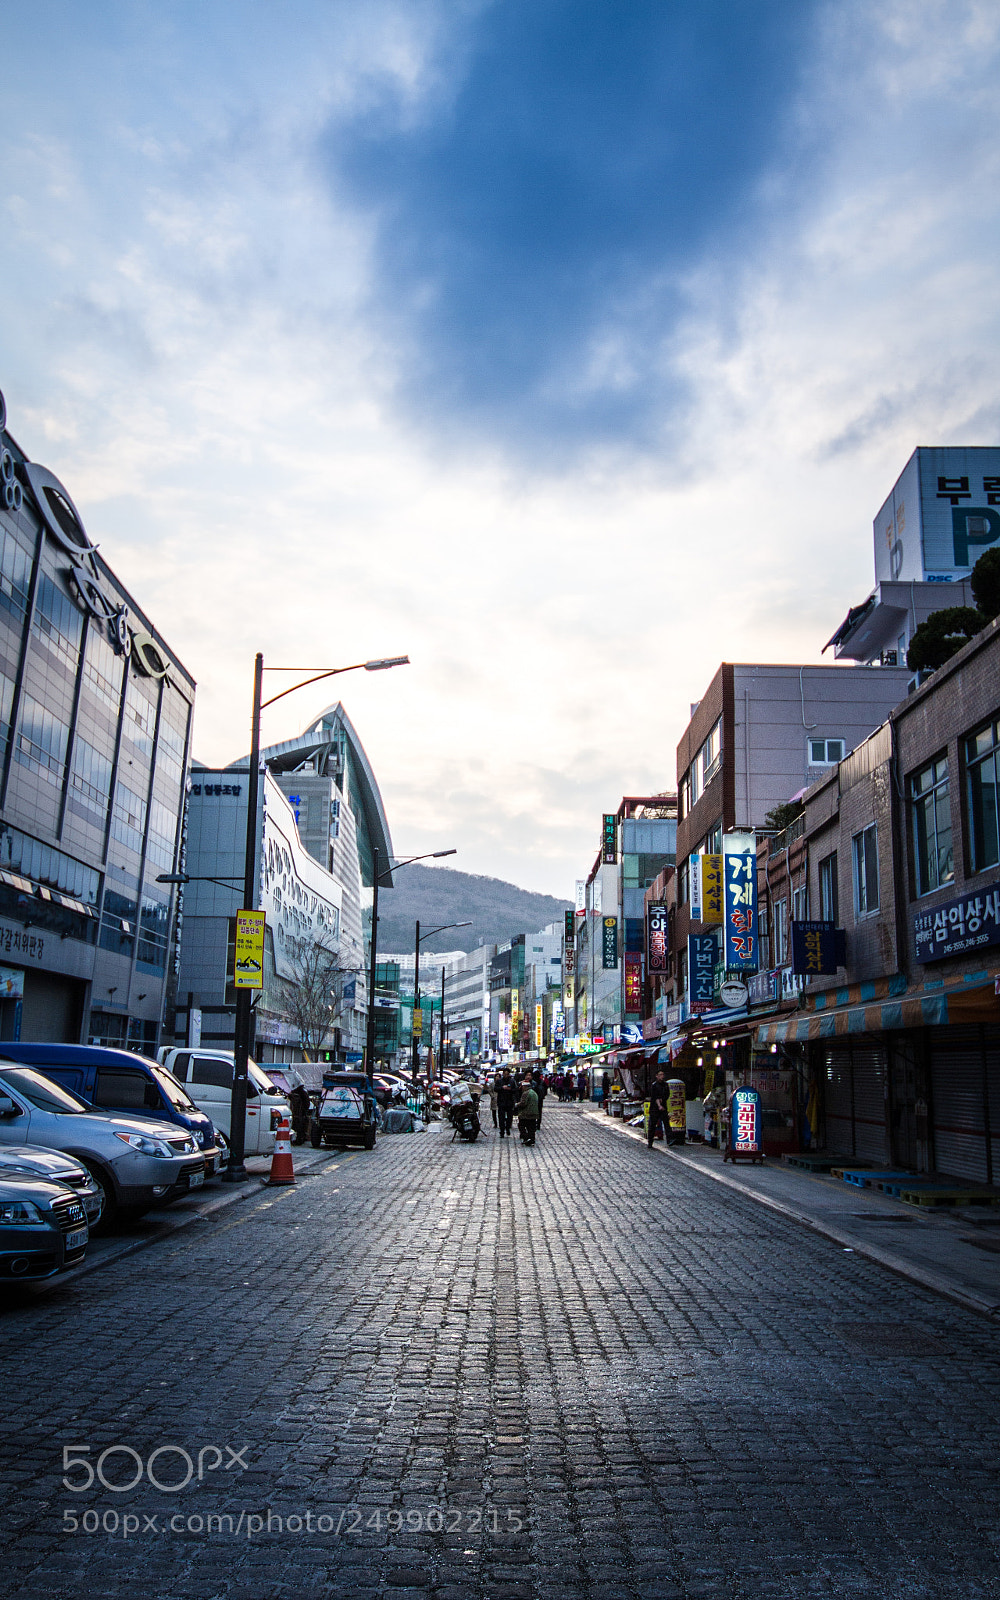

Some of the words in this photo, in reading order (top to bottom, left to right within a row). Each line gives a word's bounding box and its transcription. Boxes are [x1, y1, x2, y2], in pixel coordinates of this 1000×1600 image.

[189, 784, 202, 796] 업
[933, 890, 1000, 942] 삼익상사
[804, 931, 824, 972] 삼익상사
[737, 1102, 756, 1142] 고래고기
